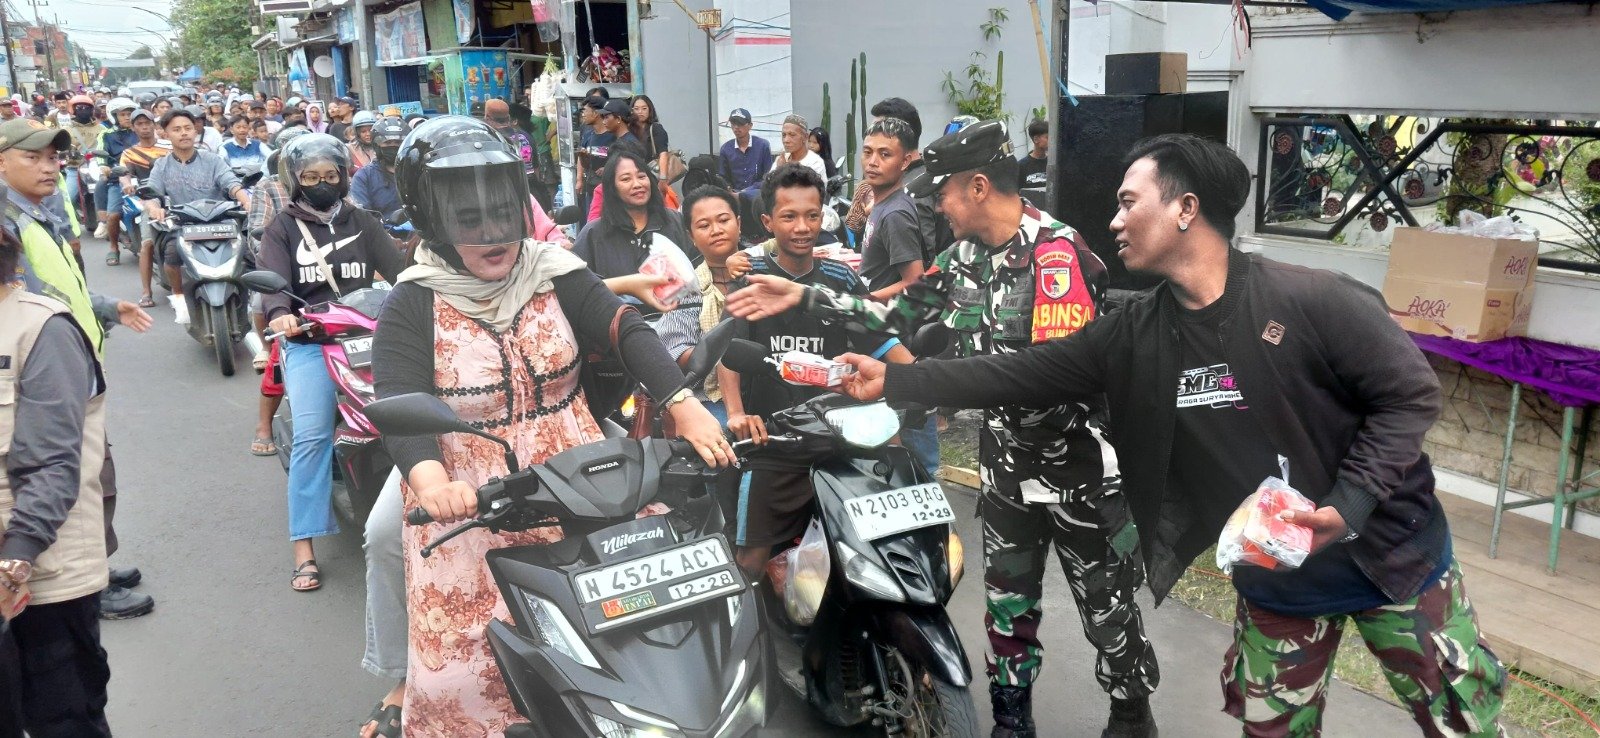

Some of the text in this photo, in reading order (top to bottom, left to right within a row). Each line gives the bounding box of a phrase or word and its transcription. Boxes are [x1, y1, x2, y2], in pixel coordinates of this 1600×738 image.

[349, 343, 359, 354] N
[588, 461, 620, 473] HONDA
[850, 502, 863, 518] N
[866, 492, 909, 515] 2103
[584, 577, 601, 600] N
[612, 558, 673, 591] 4524
[680, 545, 721, 573] ACY
